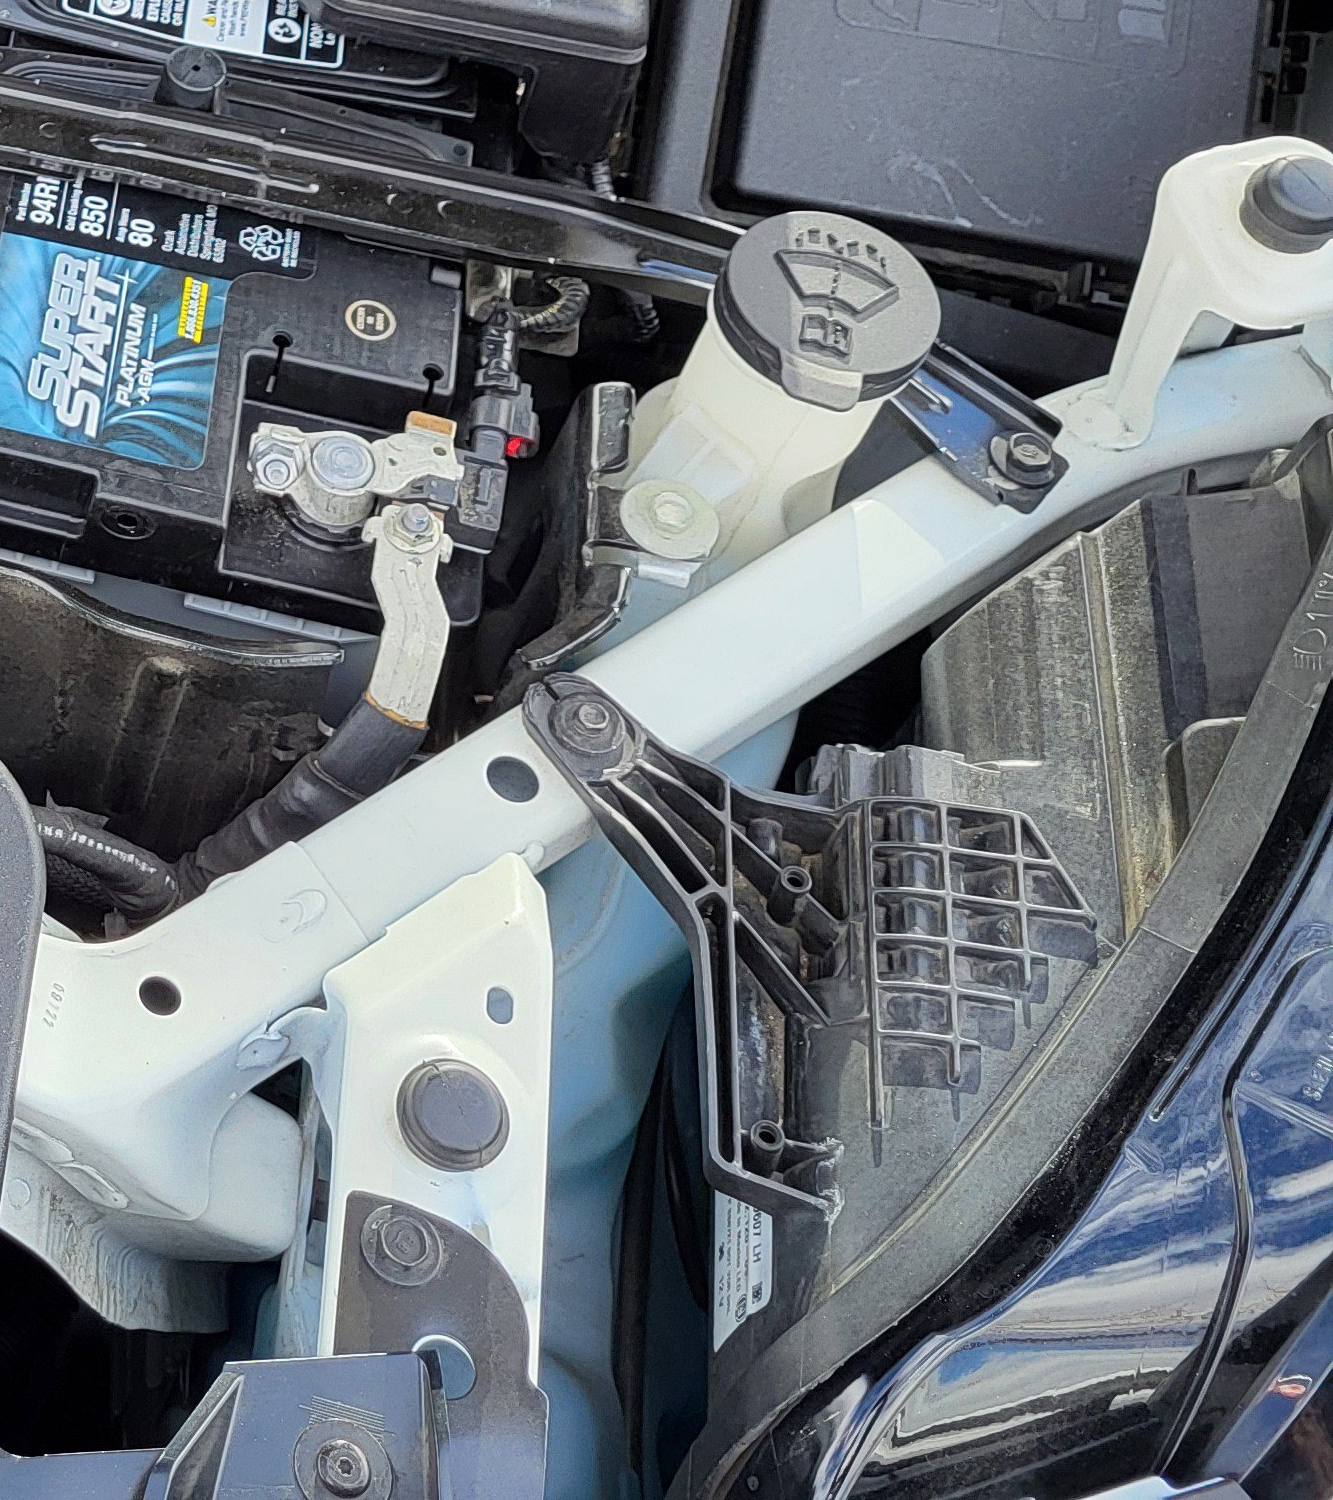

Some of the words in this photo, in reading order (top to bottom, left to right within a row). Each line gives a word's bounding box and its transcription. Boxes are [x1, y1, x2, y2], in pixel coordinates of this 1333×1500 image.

[18, 183, 31, 207] Number
[67, 189, 83, 216] Cranking
[15, 207, 27, 221] Part
[64, 216, 76, 231] Cold
[79, 196, 108, 236] 850
[115, 227, 128, 243] Amp
[128, 219, 155, 247] 80
[161, 230, 175, 252] Ozark
[174, 214, 190, 255] Automotive
[187, 214, 203, 257] Distributors
[26, 252, 88, 407] SUPER
[58, 259, 121, 438] START
[115, 302, 147, 407] PLATINUM
[137, 359, 156, 402] AGM
